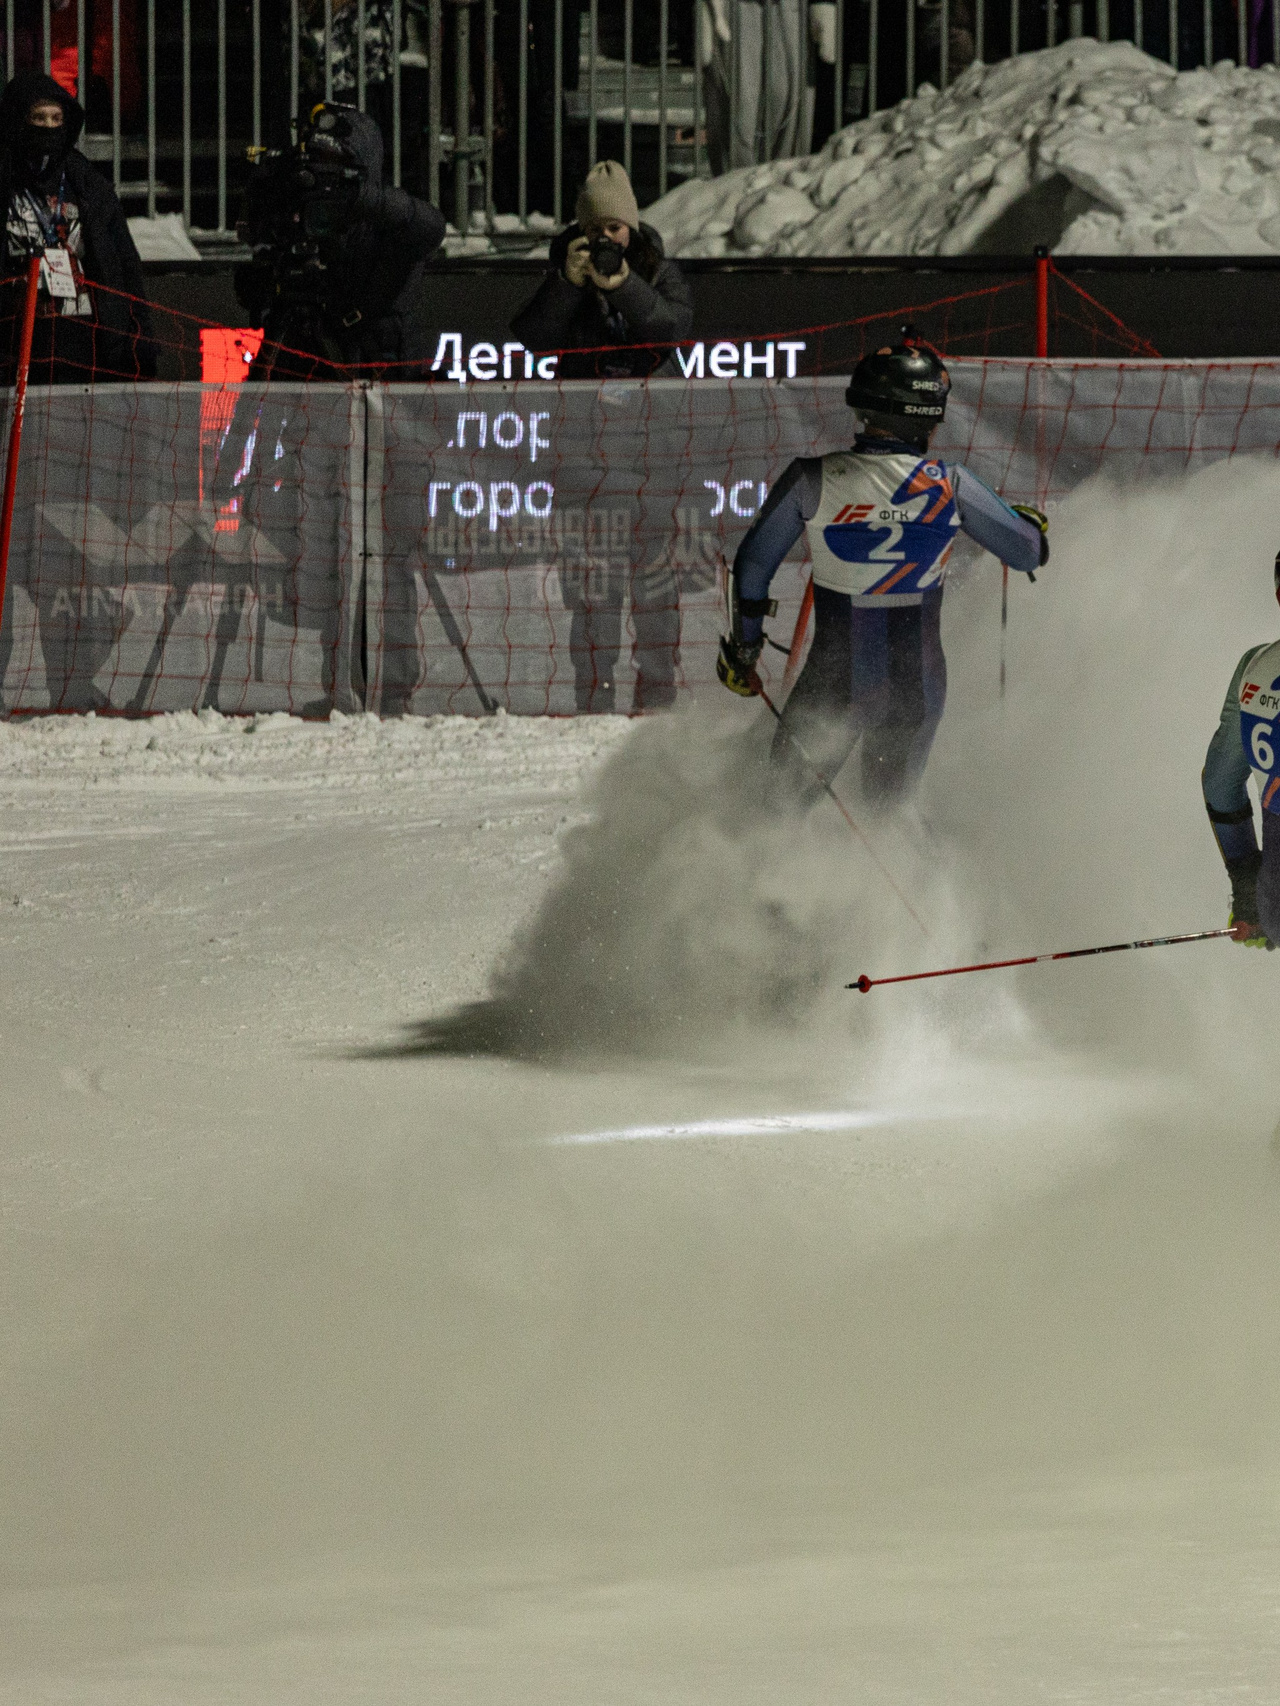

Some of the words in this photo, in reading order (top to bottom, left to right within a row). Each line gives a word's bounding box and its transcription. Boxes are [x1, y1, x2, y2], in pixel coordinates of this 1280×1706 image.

[912, 380, 940, 391] SHRED
[904, 405, 943, 416] SHRED
[879, 509, 909, 521] ФГК
[867, 521, 906, 560] 2
[1259, 694, 1280, 710] ФГК
[1250, 722, 1275, 771] 6
